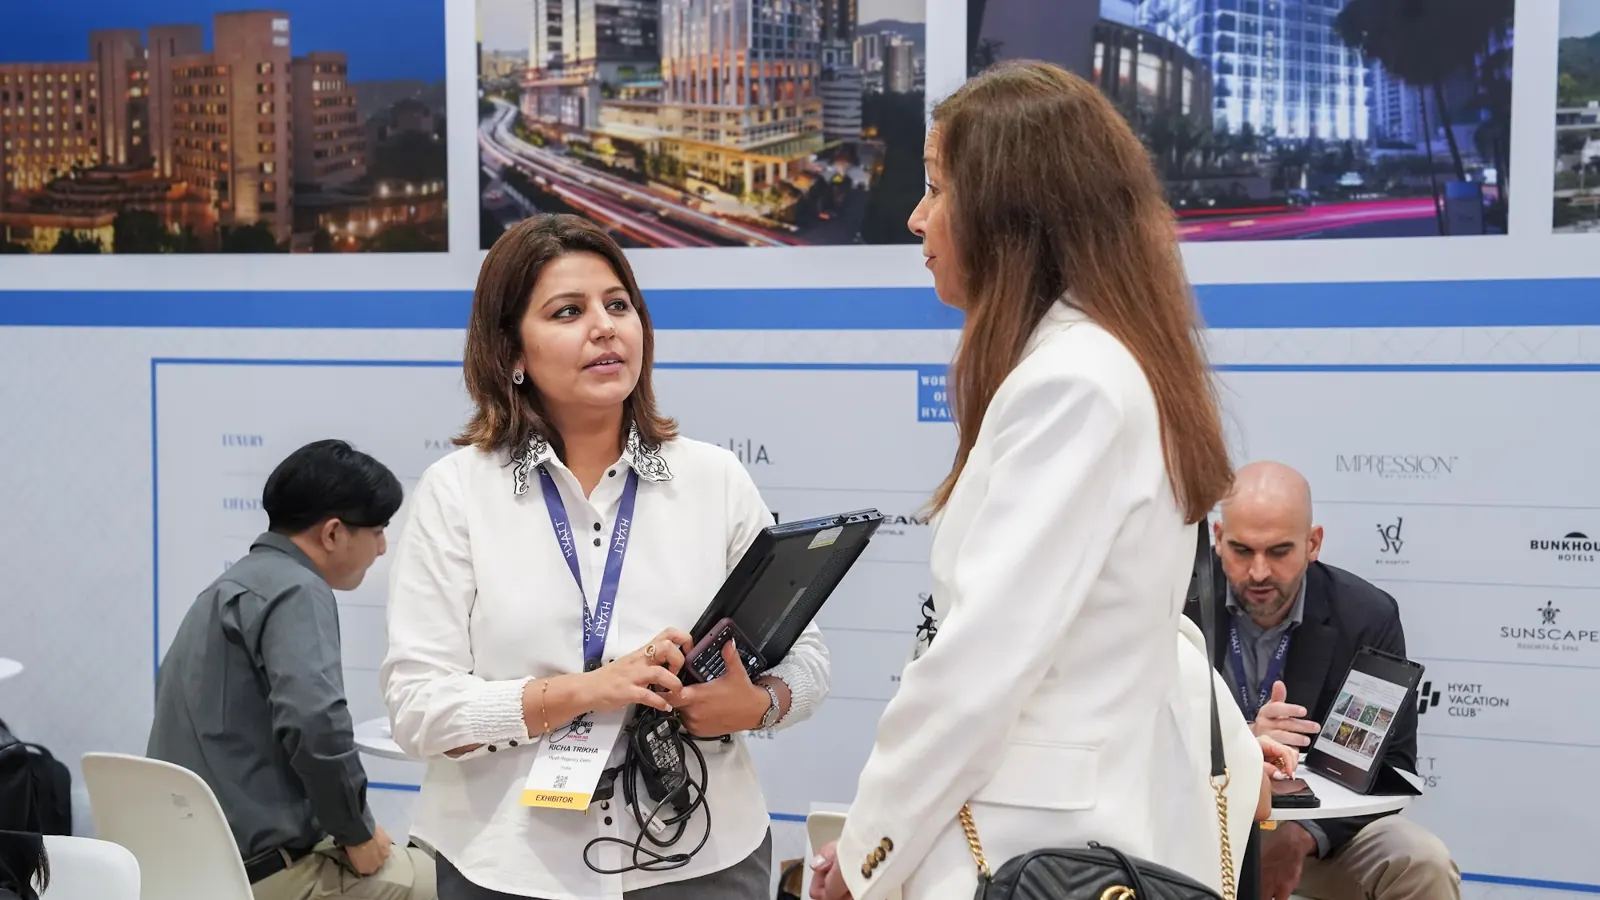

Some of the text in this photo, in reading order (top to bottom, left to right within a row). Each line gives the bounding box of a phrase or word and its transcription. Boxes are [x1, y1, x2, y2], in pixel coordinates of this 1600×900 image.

[921, 375, 948, 386] WOR
[921, 407, 951, 418] HYA
[222, 434, 263, 447] LUXURY
[1336, 454, 1453, 477] IMPRESSION
[222, 497, 263, 510] LIFEST
[555, 518, 573, 559] HYATT
[613, 518, 630, 559] HYATT
[1530, 540, 1600, 552] BUNKHOU
[1558, 554, 1595, 562] HOTELS
[594, 601, 612, 642] HYATT
[1500, 626, 1599, 642] SUNSCAPE
[1447, 683, 1482, 693] HYATT
[1448, 695, 1510, 707] VACATION
[1448, 707, 1477, 717] CLUB
[548, 744, 599, 754] RICHA TRIKHA
[535, 795, 574, 804] EXHIBITOR
